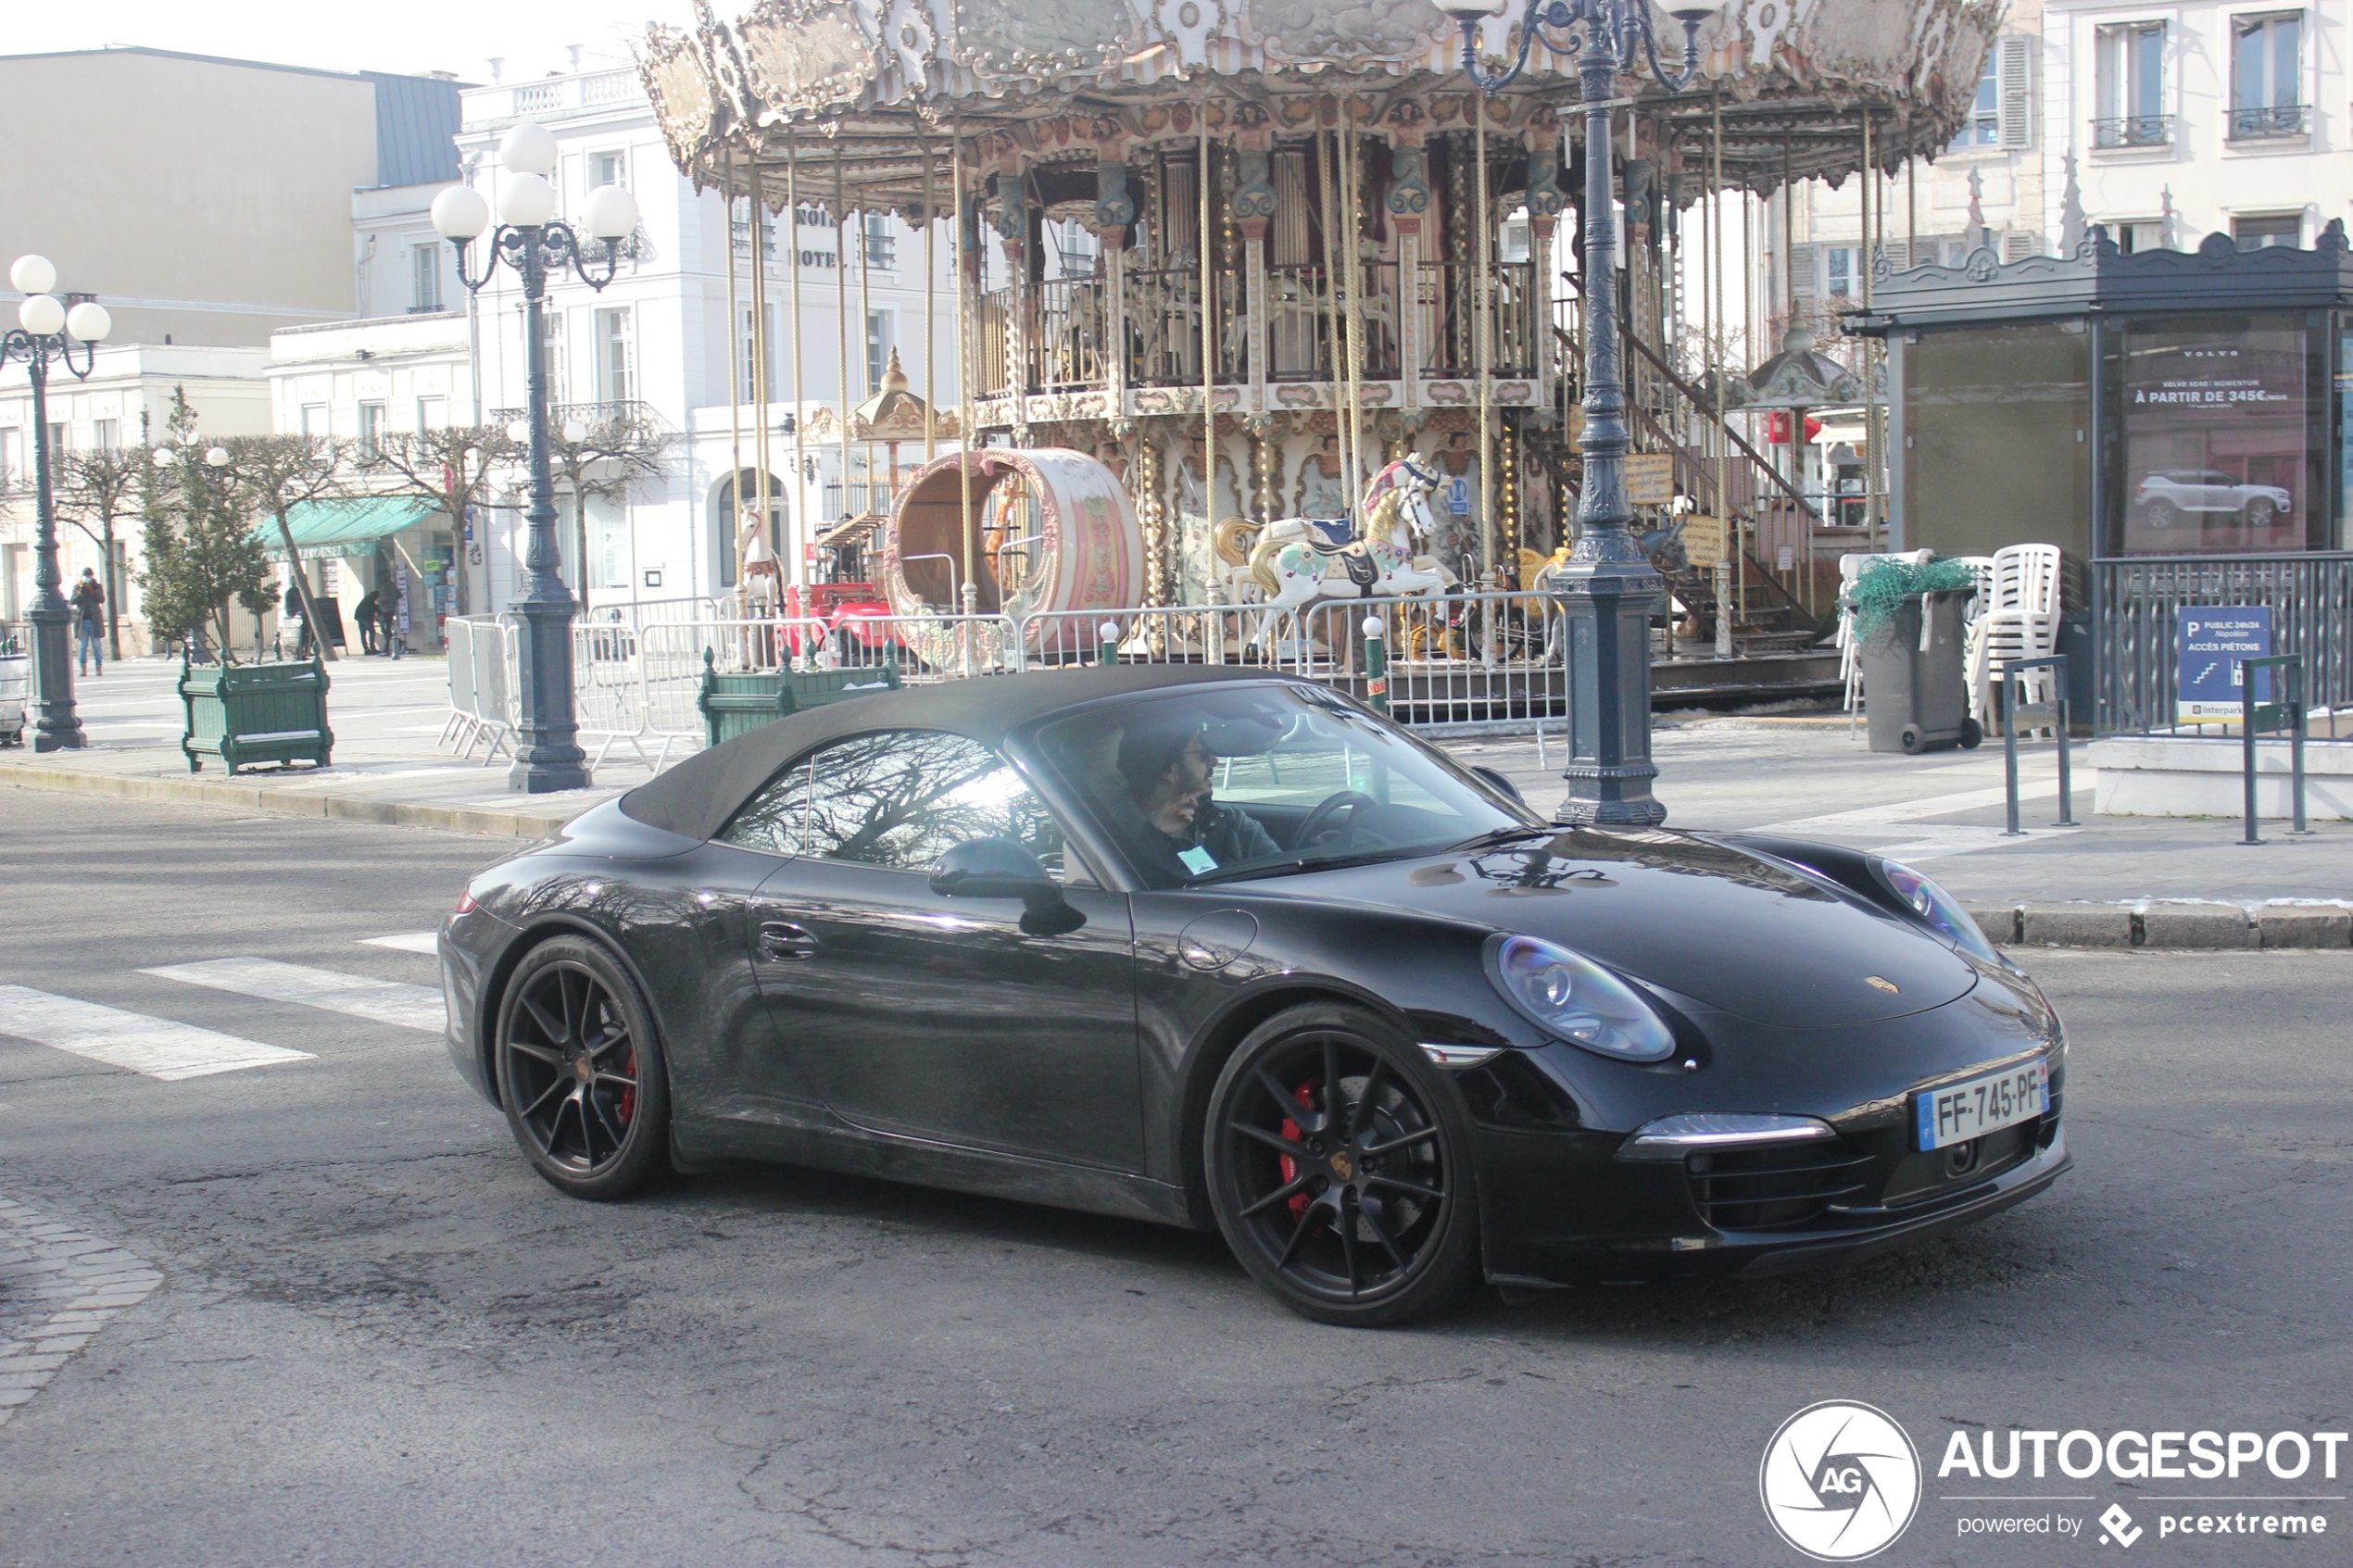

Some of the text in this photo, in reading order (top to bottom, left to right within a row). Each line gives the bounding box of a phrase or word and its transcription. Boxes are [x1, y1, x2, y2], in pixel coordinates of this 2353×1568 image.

[796, 208, 837, 228] NOI
[788, 248, 848, 268] OTE
[2134, 389, 2146, 403] À
[2149, 392, 2201, 403] PARTIR
[2205, 391, 2225, 402] DE
[2187, 621, 2200, 638] P
[2215, 630, 2249, 638] Napoléon
[2187, 641, 2260, 651] ACCÈS PIÉTONS
[1938, 1069, 2037, 1137] FF-745-PF
